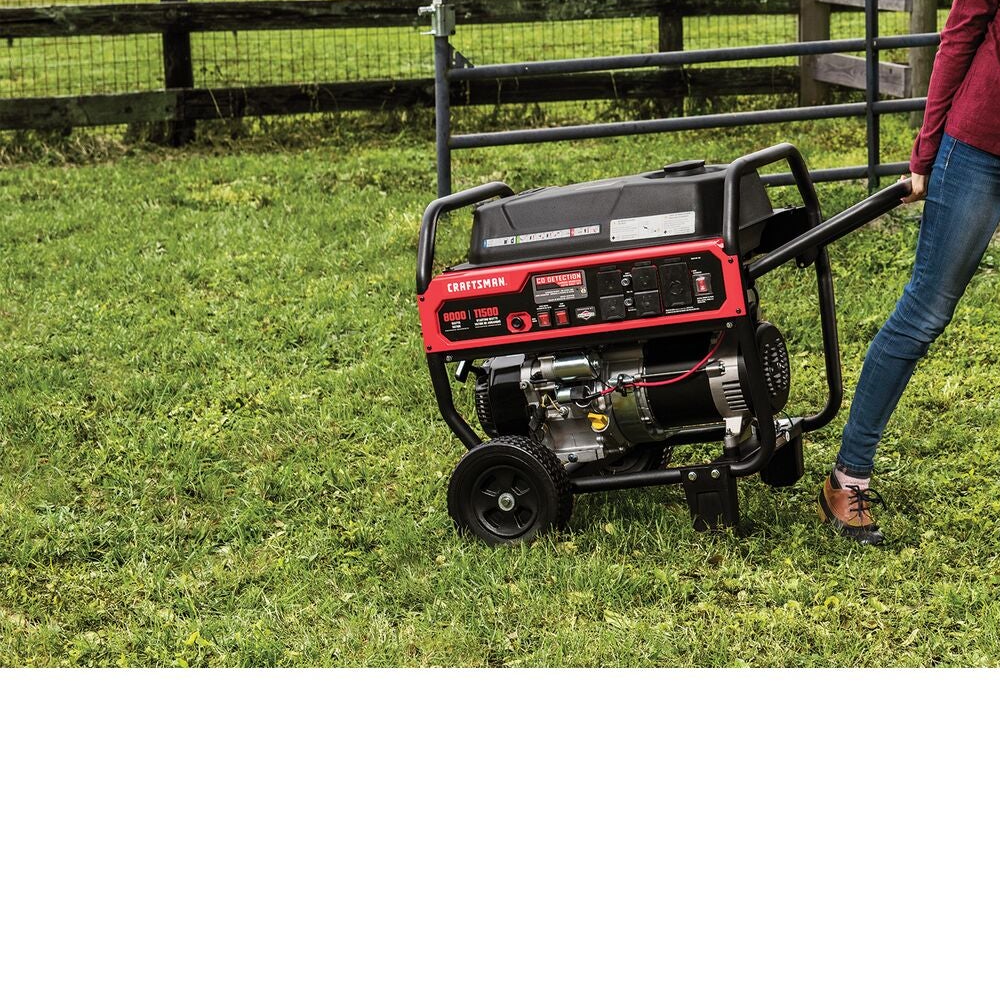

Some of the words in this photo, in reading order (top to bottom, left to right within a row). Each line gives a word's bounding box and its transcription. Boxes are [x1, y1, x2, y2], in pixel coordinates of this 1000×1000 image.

[547, 272, 581, 283] DETECTION
[447, 276, 505, 293] CRAFTSMAN
[443, 311, 467, 322] 8000
[473, 306, 499, 318] 11500
